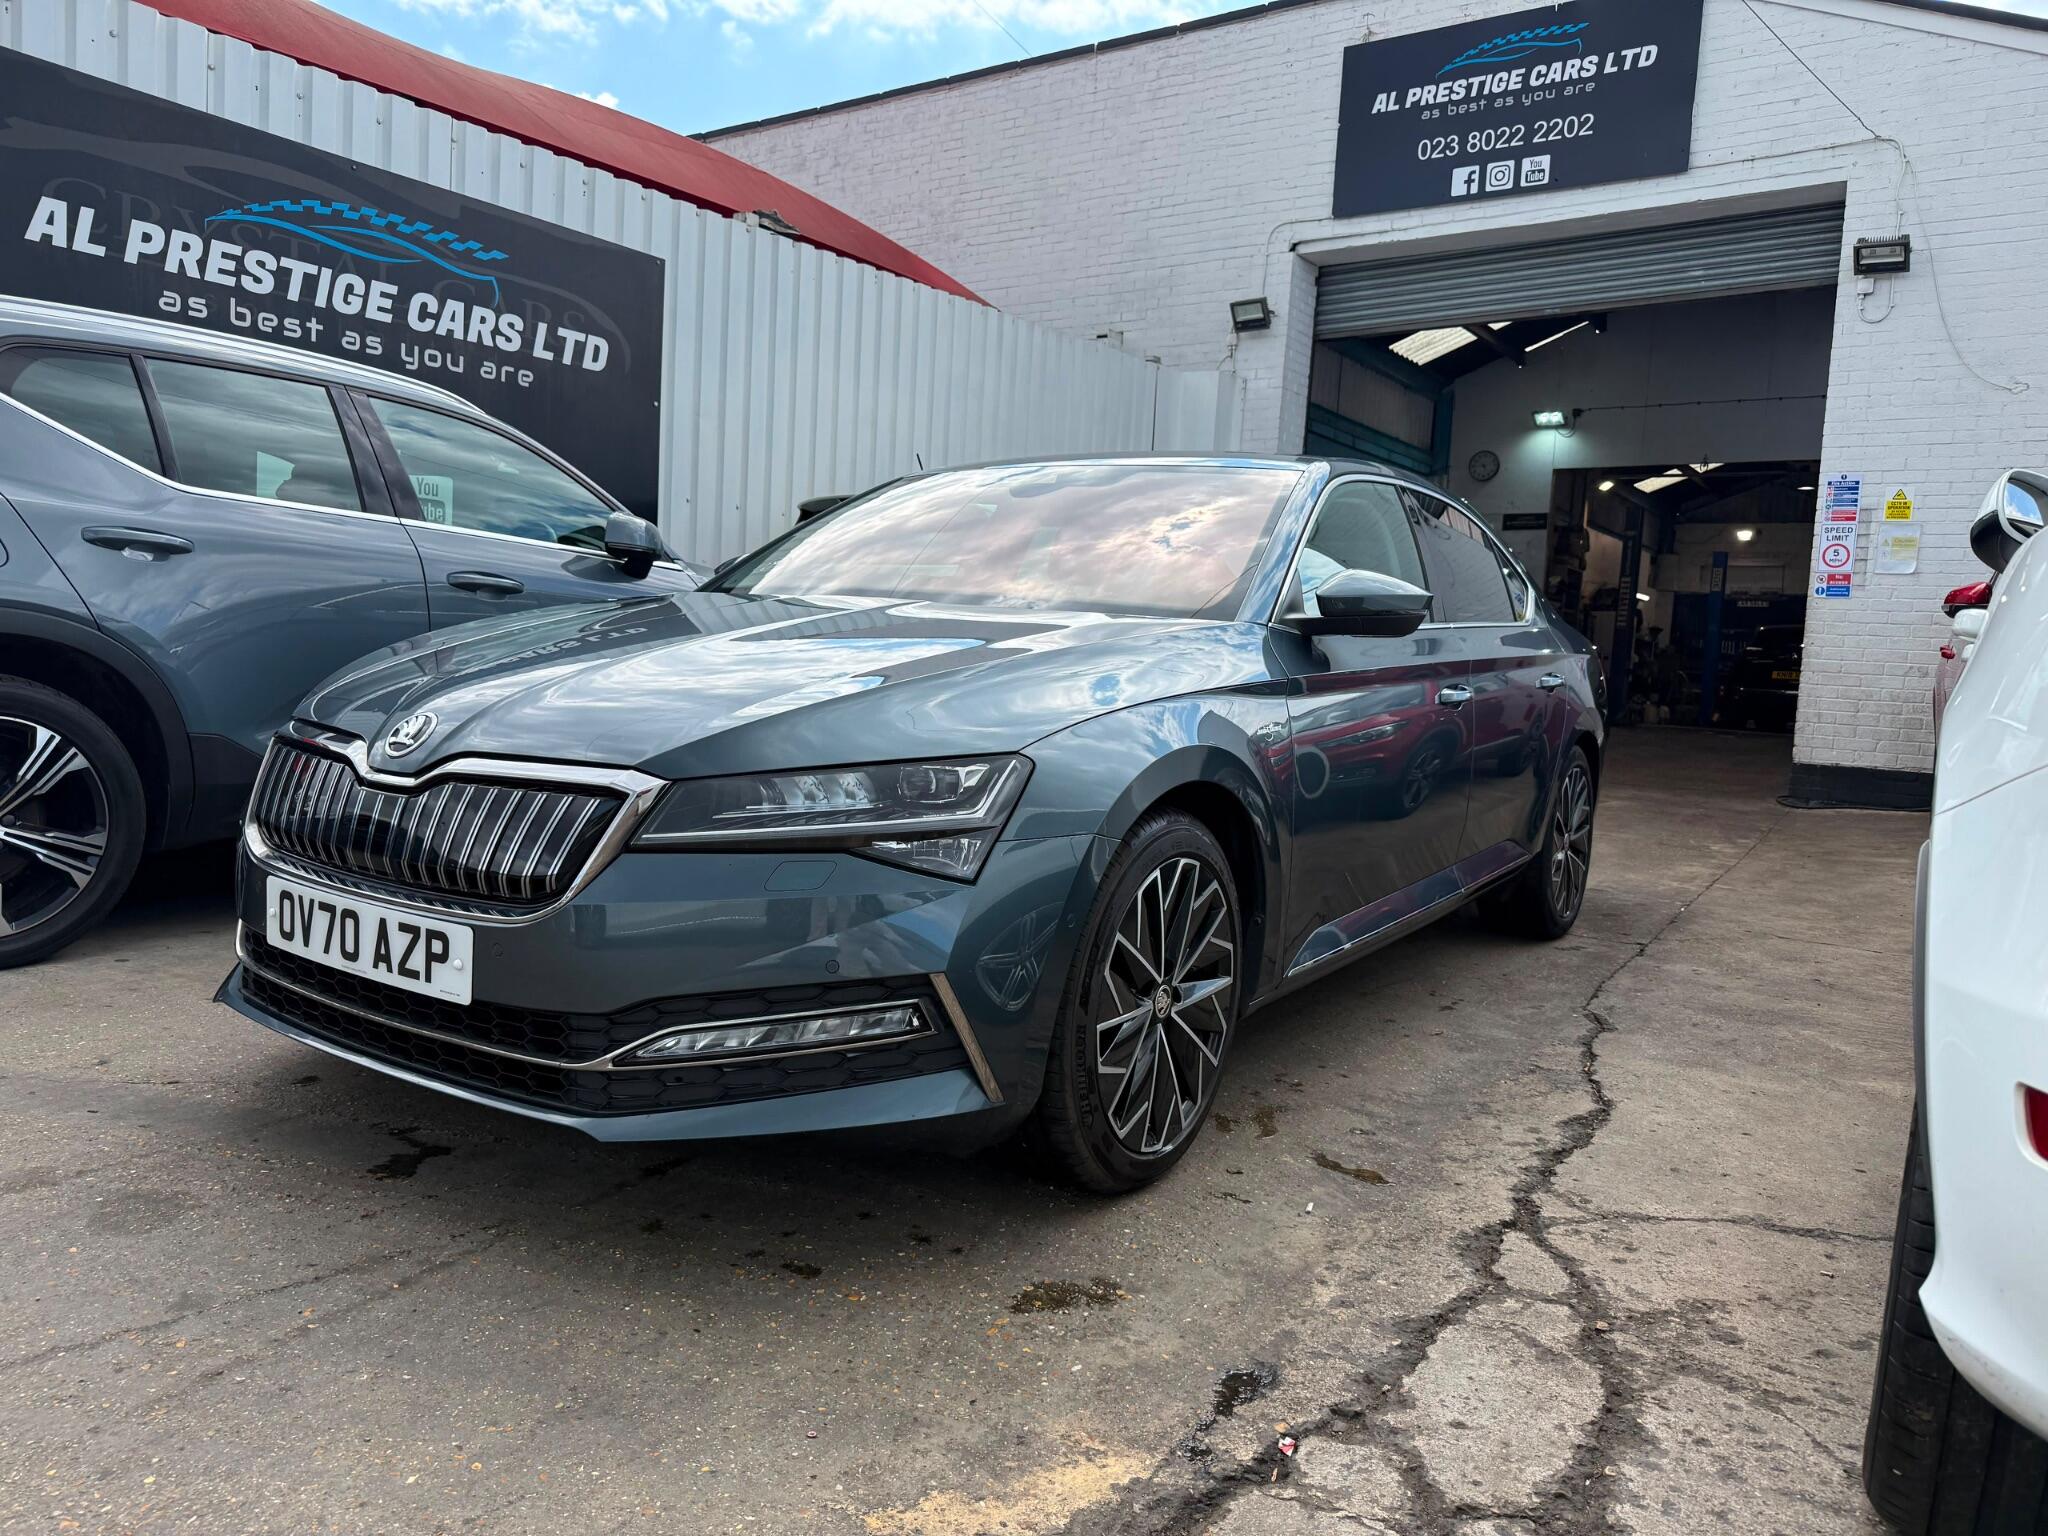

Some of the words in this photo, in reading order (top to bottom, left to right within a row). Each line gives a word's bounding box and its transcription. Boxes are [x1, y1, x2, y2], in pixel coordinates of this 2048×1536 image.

[1371, 92, 1400, 115] AL
[1405, 68, 1526, 109] PRESTIGE
[1529, 55, 1599, 88] CARS
[1603, 44, 1659, 75] LTD
[1421, 108, 1440, 120] as
[1448, 98, 1487, 116] best
[1494, 96, 1514, 108] as
[1522, 90, 1556, 106] you
[1563, 82, 1596, 96] are
[1417, 135, 1459, 161] 023
[1466, 124, 1525, 153] 8022
[1533, 113, 1595, 144] 2202
[1527, 170, 1545, 182] Tube
[1529, 158, 1543, 169] You
[24, 196, 106, 257] AL
[124, 219, 399, 323] PRESTIGE
[408, 292, 523, 352] CARS
[533, 323, 609, 373] LTD
[159, 290, 208, 318] as
[230, 297, 324, 343] best
[341, 331, 382, 355] as
[401, 342, 464, 373] you
[481, 362, 534, 387] are
[416, 477, 438, 497] You
[421, 502, 443, 521] ube
[1833, 549, 1840, 557] 5
[279, 889, 361, 963] OV70
[372, 917, 451, 984] AZP
